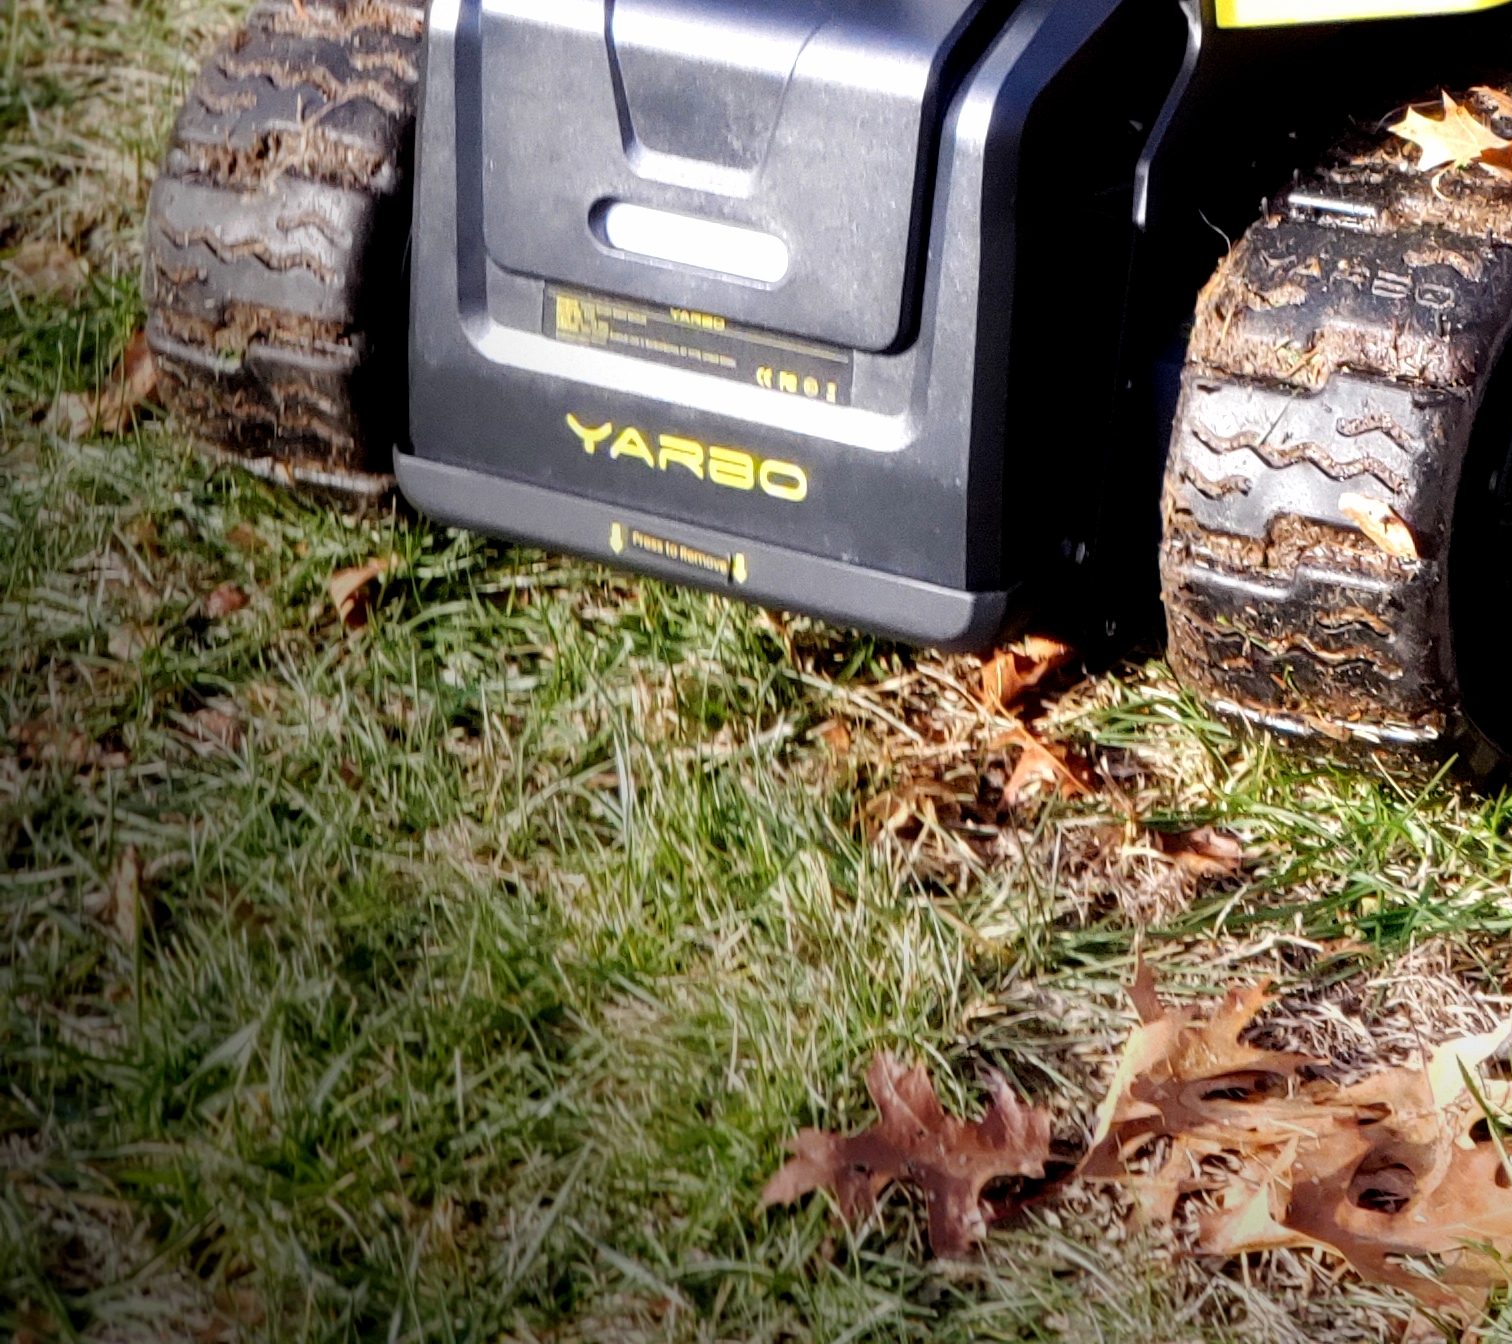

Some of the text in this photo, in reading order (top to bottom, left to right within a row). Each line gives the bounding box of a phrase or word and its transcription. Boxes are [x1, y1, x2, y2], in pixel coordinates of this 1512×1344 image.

[669, 306, 726, 332] YARBO
[566, 412, 809, 502] YARBO
[632, 530, 728, 576] Press to Remove
